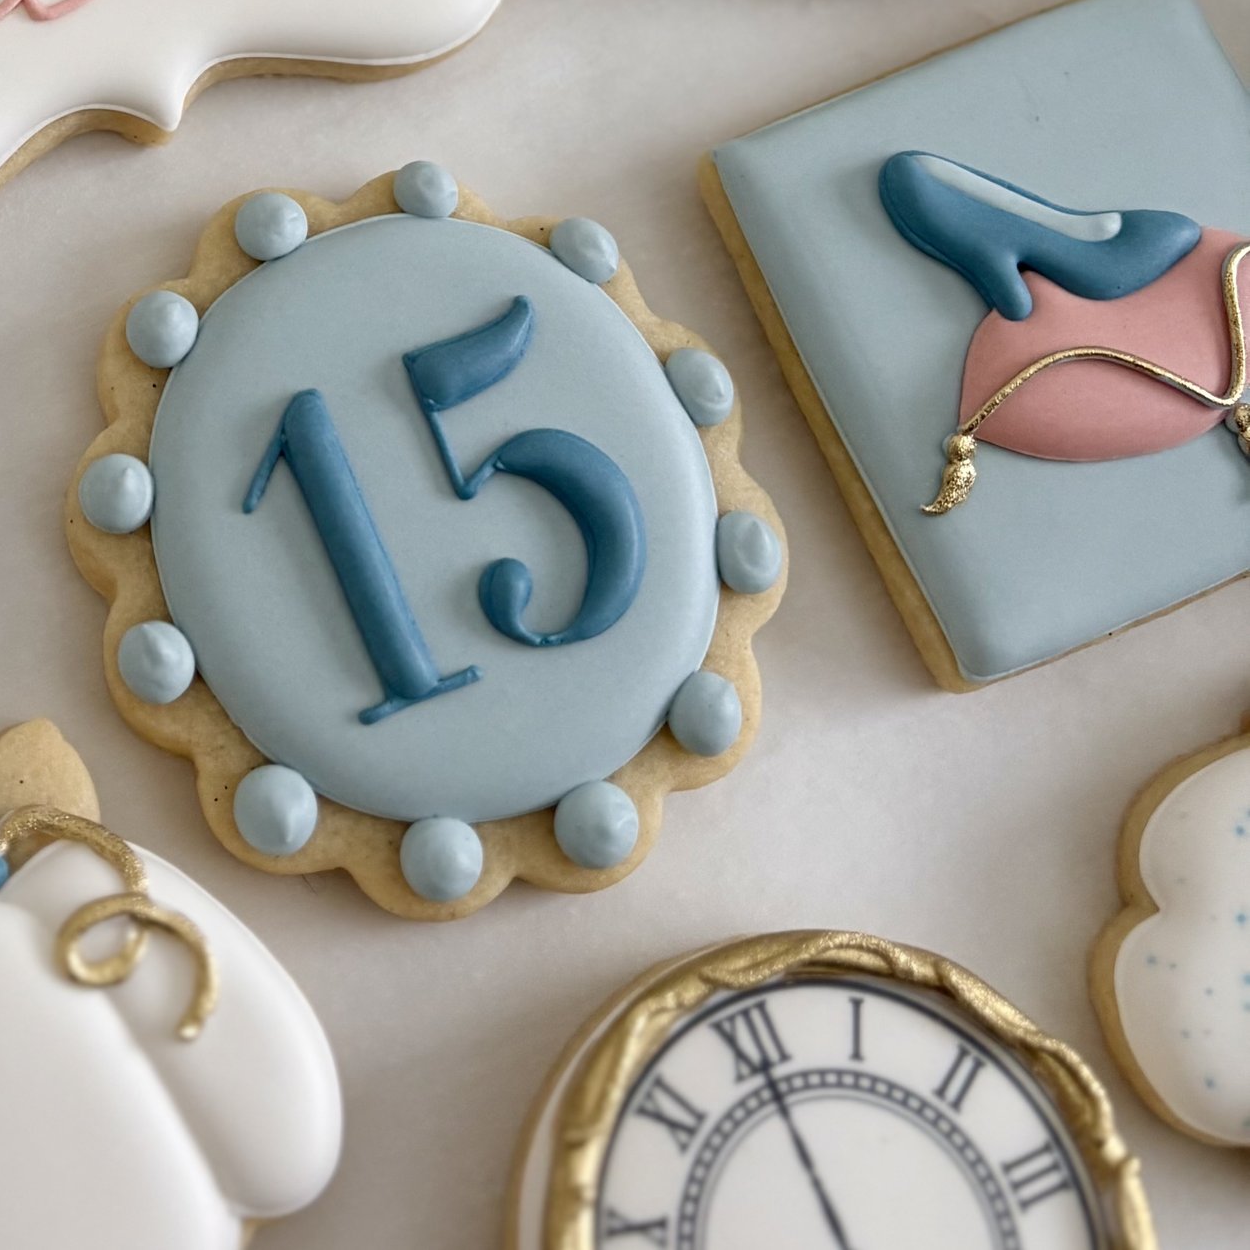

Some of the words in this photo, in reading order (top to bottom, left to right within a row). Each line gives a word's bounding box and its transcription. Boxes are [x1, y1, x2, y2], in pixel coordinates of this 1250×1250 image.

[242, 294, 648, 726] 15
[709, 999, 792, 1085] XII
[848, 996, 865, 1063] I
[634, 1072, 708, 1155] XI
[933, 1042, 986, 1115] II
[1001, 1140, 1074, 1214] III
